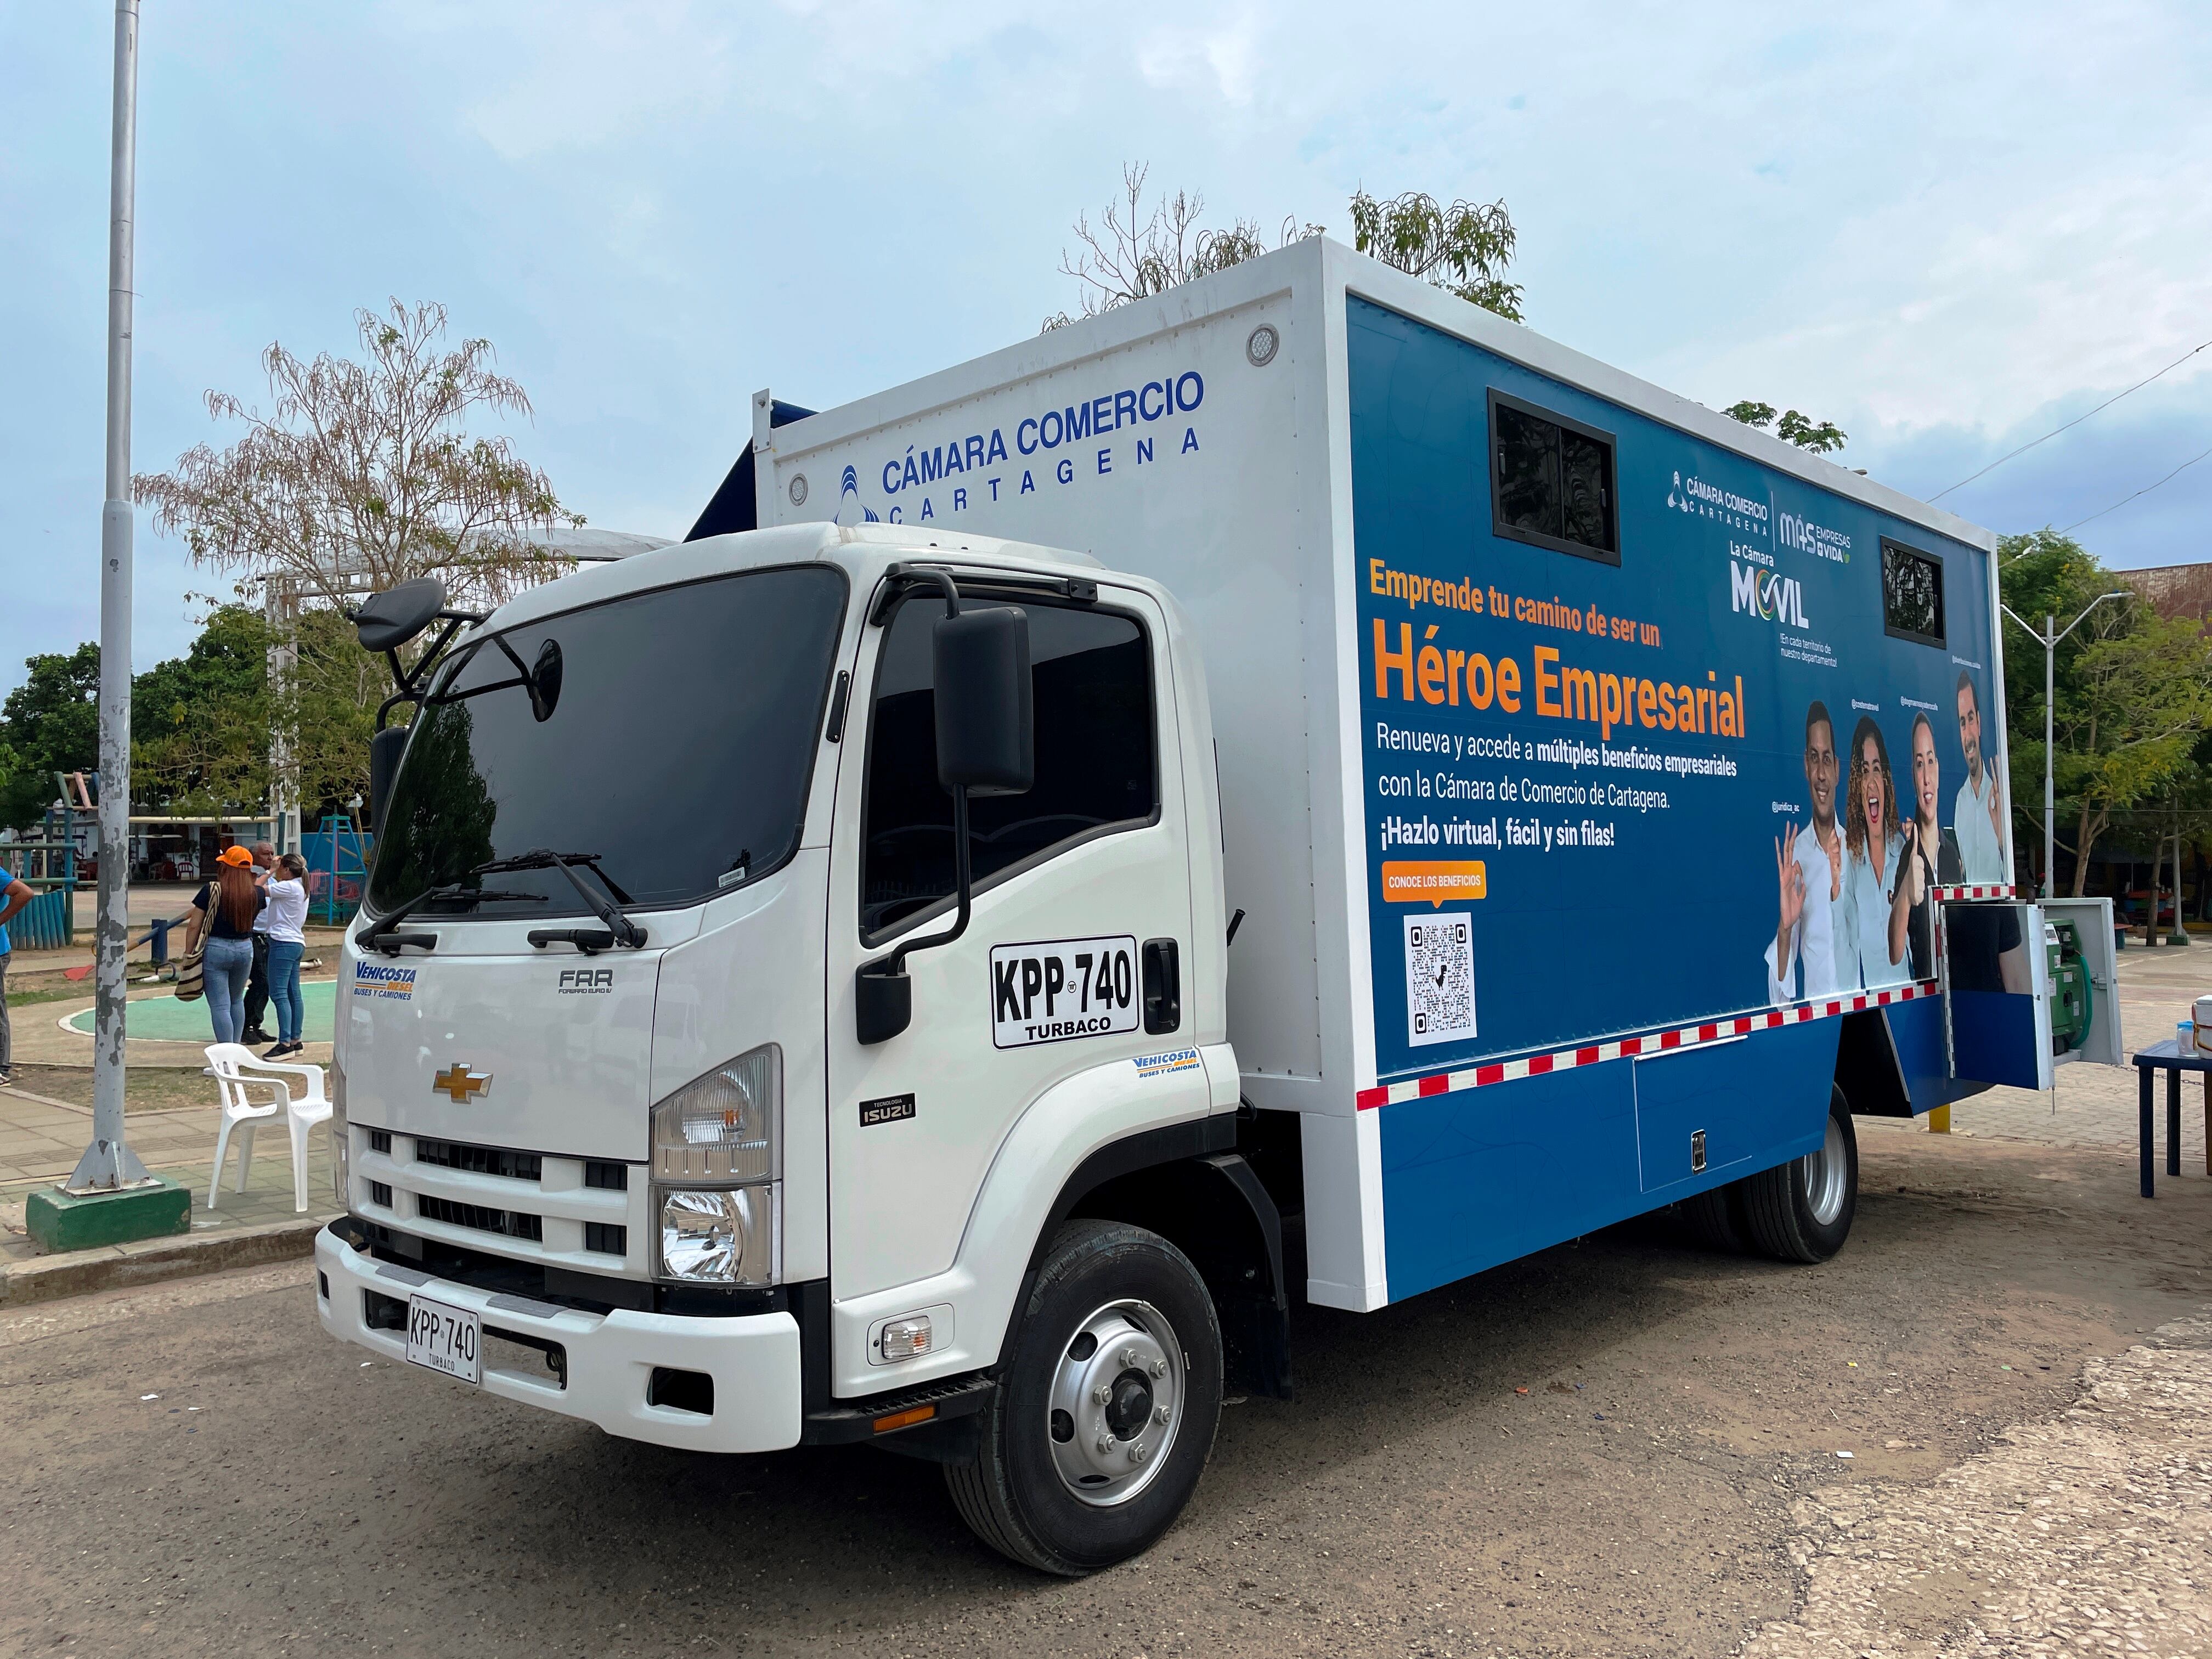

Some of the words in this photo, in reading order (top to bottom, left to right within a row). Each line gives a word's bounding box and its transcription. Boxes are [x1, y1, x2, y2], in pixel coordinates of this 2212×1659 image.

[882, 428, 1008, 494] CÁMARA
[1017, 371, 1204, 455] COMERCIO
[889, 427, 1199, 524] CARTAGENA
[1686, 476, 1724, 506] CÁMARA
[1725, 493, 1768, 521] COMERCIO
[1689, 500, 1767, 537] CARTAGENA
[1816, 526, 1851, 549] EMPRESAS
[1730, 540, 1741, 557] La
[1742, 544, 1774, 567] Cámara
[1369, 558, 1484, 614] Emprende
[1488, 585, 1510, 618] tu
[1515, 596, 1582, 632] camino
[1586, 603, 1607, 637] de
[1611, 617, 1637, 642] ser
[1640, 623, 1660, 647] un
[1781, 648, 1801, 660] nuestro
[1789, 636, 1802, 647] cada
[1802, 639, 1824, 653] territorio
[1825, 643, 1831, 654] de
[1373, 618, 1521, 713] Héroe
[1534, 645, 1745, 741] Empresarial
[1376, 722, 1451, 754] Renueva
[1454, 735, 1464, 761] y
[1468, 733, 1521, 759] accede
[1525, 742, 1533, 761] a
[1537, 738, 1599, 770] múltiples
[1601, 742, 1662, 771] beneficios
[1664, 754, 1737, 778] empresariales
[1379, 775, 1412, 797] con
[1416, 769, 1431, 798] la
[1435, 772, 1495, 800] Cámara
[1499, 775, 1517, 802] de
[1521, 777, 1586, 805] Comercio
[1589, 781, 1605, 806] de
[1607, 783, 1671, 814] Cartagena.
[1380, 815, 1440, 851] ¡Hazlo
[1443, 816, 1502, 851] virtual,
[1505, 817, 1540, 845] fácil
[1543, 826, 1553, 852] y
[1556, 819, 1578, 846] sin
[1581, 820, 1615, 847] filas!
[1389, 876, 1422, 888] CONOCE
[1423, 876, 1437, 888] LOS
[1438, 874, 1481, 887] BENEFICIOS
[357, 961, 417, 983] VEHICOSTA
[379, 990, 412, 1001] CAMIONES
[387, 981, 414, 992] DIESEL
[994, 956, 1065, 1024] KPP
[1075, 950, 1132, 1013] 740
[1025, 1017, 1111, 1040] TURBACO
[1132, 1050, 1197, 1068] VEHICOSTA
[1139, 1070, 1159, 1078] BUSES
[1167, 1063, 1200, 1073] CAMIONES
[1173, 1058, 1197, 1066] DIESEL
[864, 1104, 912, 1122] ISUZU
[410, 1307, 440, 1350] KPP
[445, 1317, 475, 1362] 740
[429, 1353, 455, 1372] TURBACO
